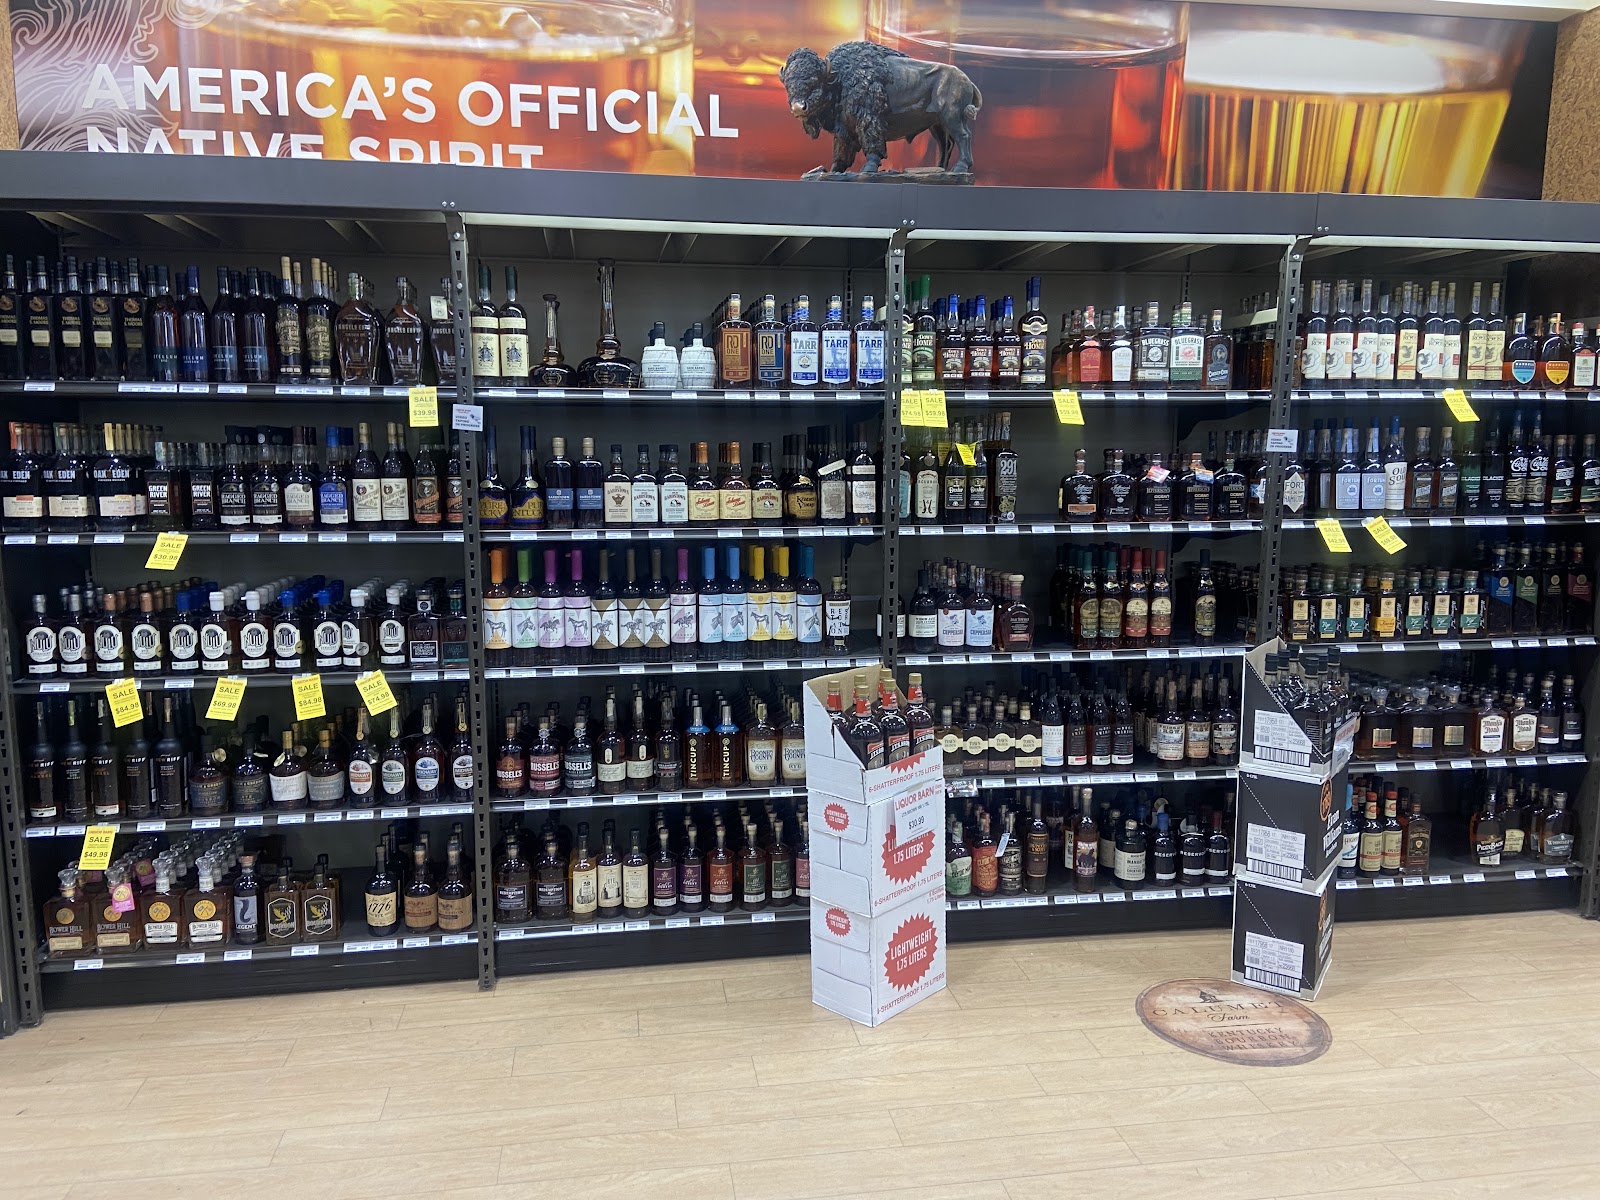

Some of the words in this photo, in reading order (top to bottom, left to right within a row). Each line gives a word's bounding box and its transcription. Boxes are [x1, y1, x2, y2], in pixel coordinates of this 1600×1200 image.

[81, 63, 437, 123] AMERICA'S
[458, 80, 739, 138] OFFICIAL
[792, 338, 817, 350] TARR
[825, 339, 848, 348] TARR
[860, 339, 882, 348] TARR
[1142, 338, 1170, 346] BLUEGRASS
[1000, 459, 1017, 475] 291
[12, 470, 30, 479] EDEN
[58, 470, 76, 478] EDEN
[94, 470, 106, 478] OAK
[112, 470, 130, 478] EDEN
[1285, 482, 1304, 490] FORT
[480, 500, 503, 510] PURE
[1373, 524, 1387, 534] SALE
[219, 687, 240, 695] SALE
[298, 683, 319, 692] SALE
[362, 680, 382, 693] SALE
[112, 688, 134, 700] SALE
[368, 692, 390, 706] $74.98
[212, 700, 237, 708] $69.98
[298, 697, 322, 707] $84.98
[115, 702, 139, 714] $84.98
[531, 762, 560, 771] RUSSELL'S
[496, 770, 522, 778] RUSSELL'S
[868, 773, 914, 793] 6-SHATTERPROOF
[914, 770, 924, 779] 1.75
[924, 764, 941, 776] LITERS
[895, 793, 917, 811] LIQUOR
[917, 786, 934, 801] BARN
[909, 816, 925, 830] $30.99
[893, 852, 904, 865] 1.75
[905, 842, 924, 860] LITERS
[917, 878, 926, 888] 1.75
[927, 870, 943, 883] LITERS
[367, 898, 391, 913] 1776
[828, 914, 848, 924] LIGHTWEIGHT
[891, 929, 933, 960] LIGHTWEIGHT
[896, 960, 908, 972] 1.75
[908, 948, 927, 966] LITERS
[920, 981, 929, 992] 1.75
[930, 972, 945, 987] LITERS
[1152, 1001, 1284, 1017] CALUMET
[1206, 1013, 1250, 1022] Farm
[1208, 1027, 1284, 1038] KENTUCKY
[1216, 1034, 1292, 1045] BOURBON
[1224, 1040, 1300, 1052] WHISKEY
